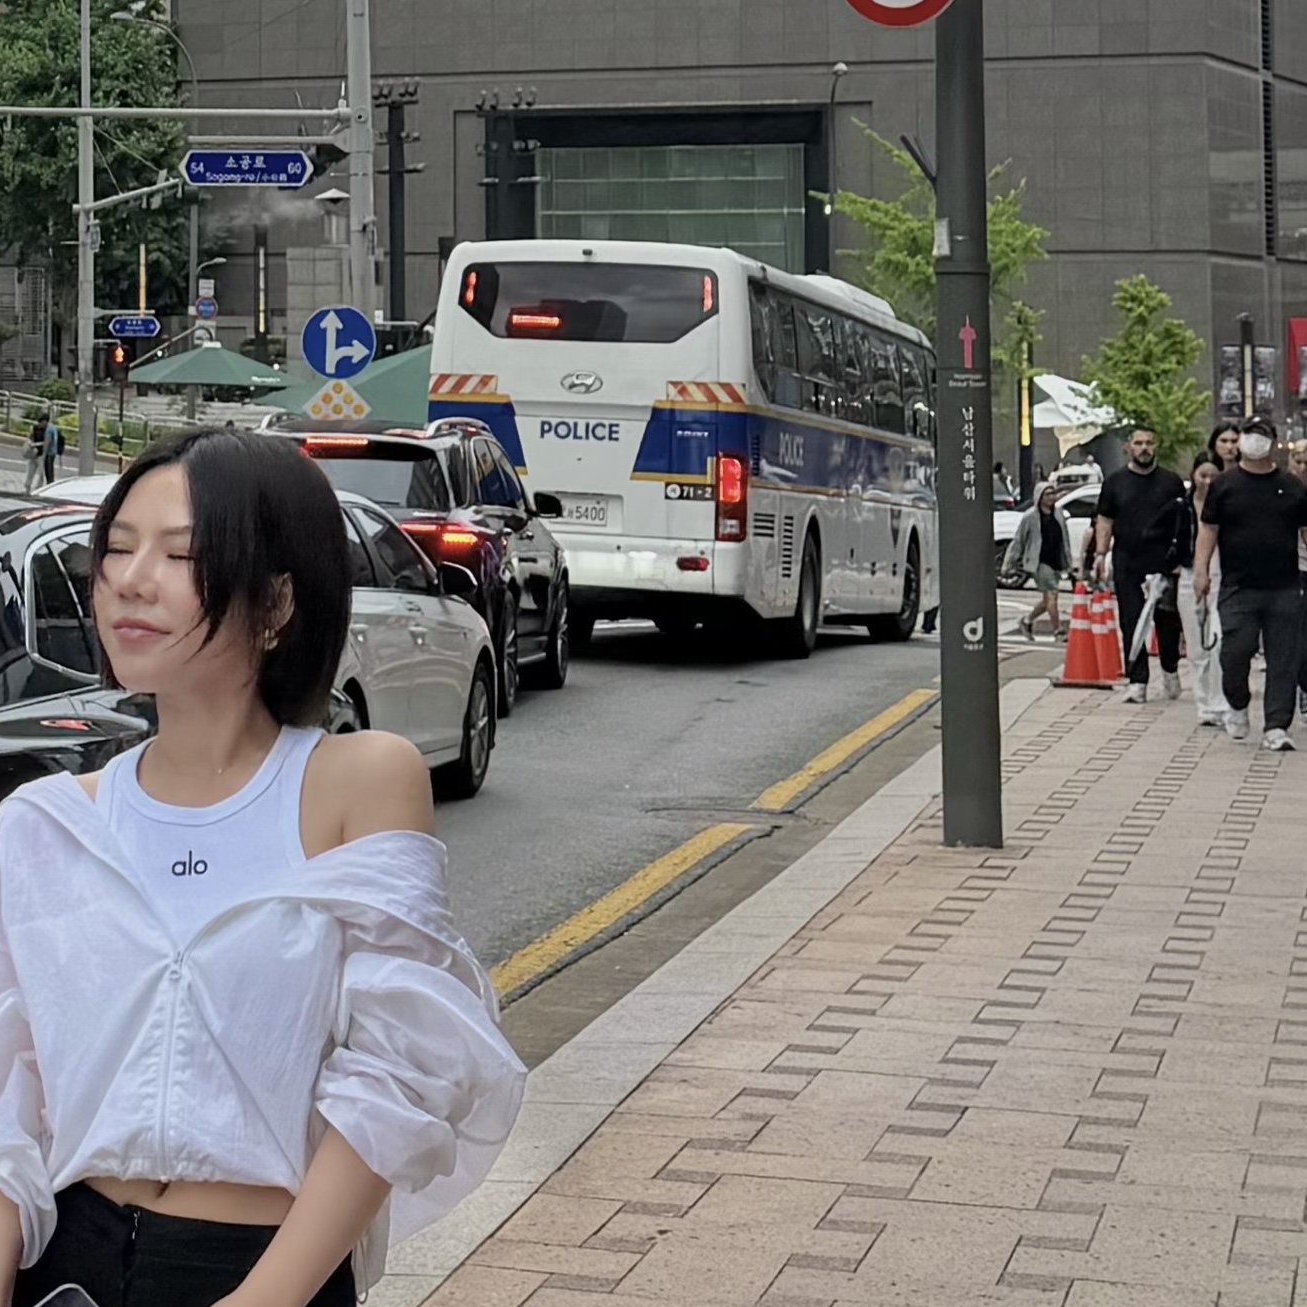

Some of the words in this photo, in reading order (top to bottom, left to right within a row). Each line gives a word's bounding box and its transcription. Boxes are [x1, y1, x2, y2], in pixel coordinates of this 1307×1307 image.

[225, 155, 266, 170] 소공로
[540, 420, 620, 442] POLICE
[171, 850, 208, 877] alo
